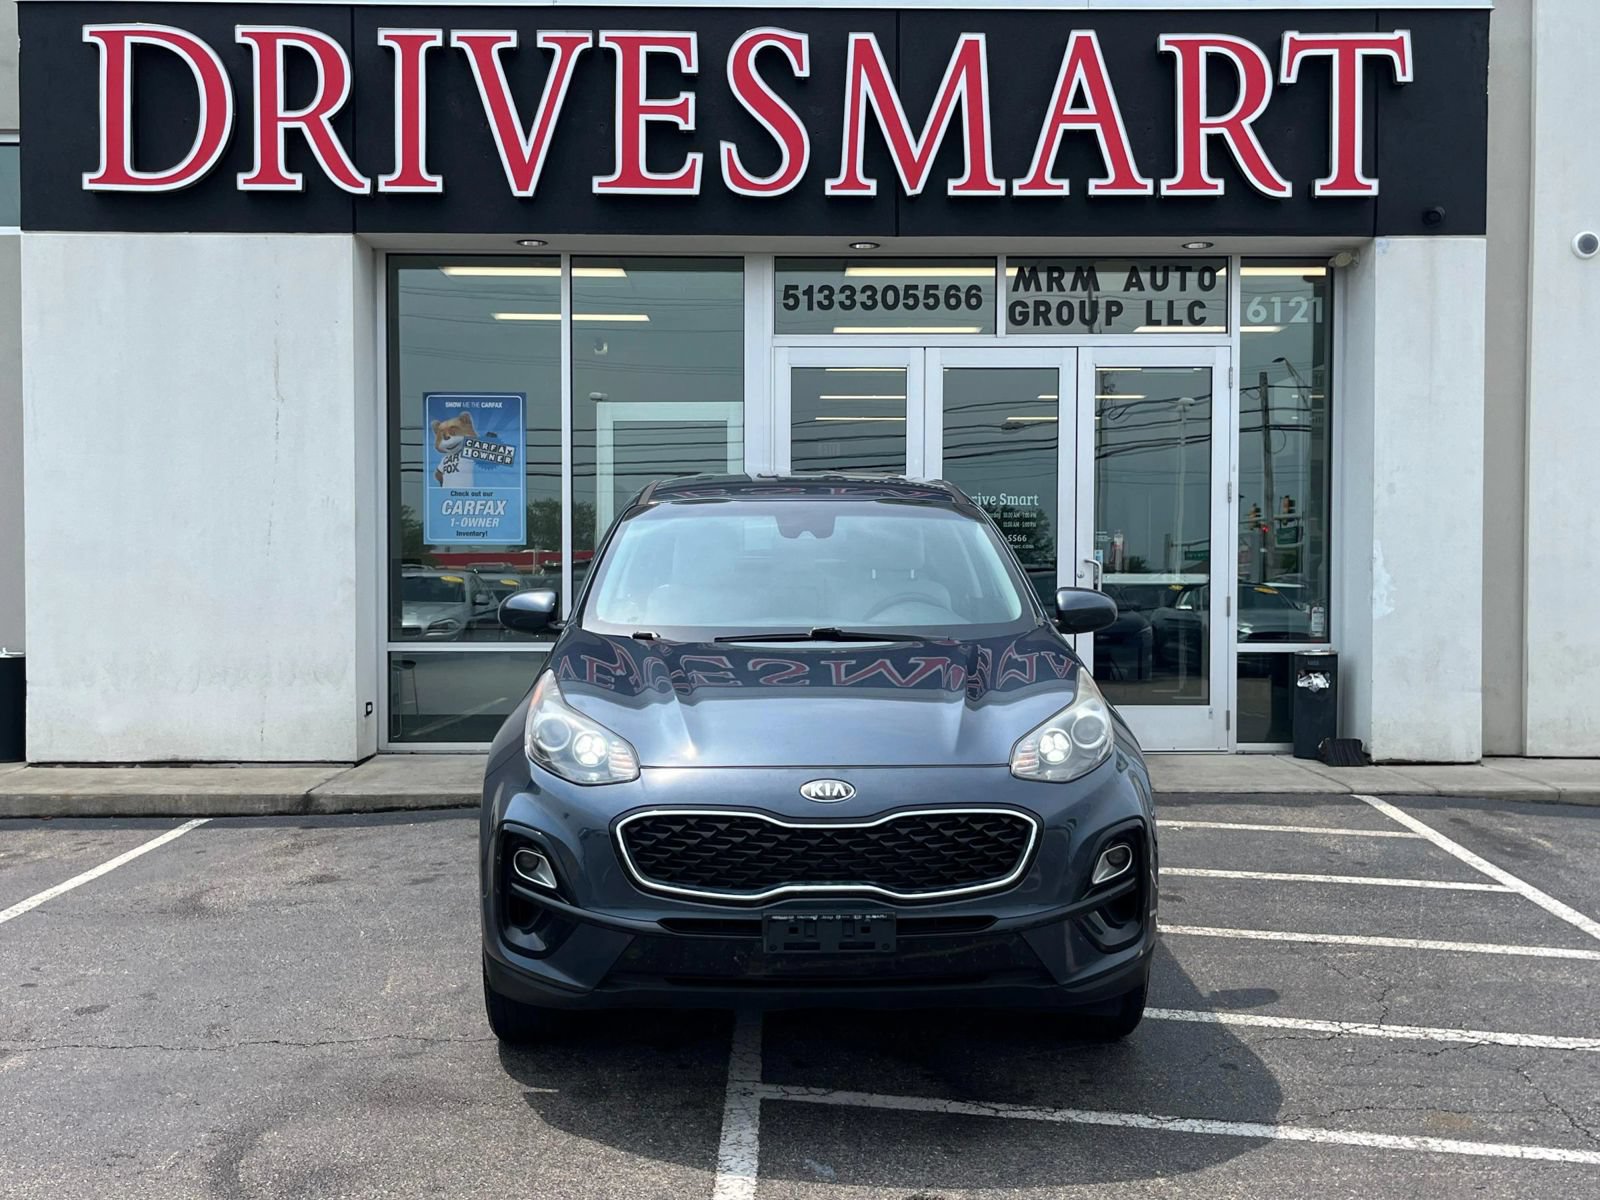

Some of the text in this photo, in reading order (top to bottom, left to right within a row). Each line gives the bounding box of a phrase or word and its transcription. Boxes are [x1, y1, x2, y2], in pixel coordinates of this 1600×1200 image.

[82, 24, 1413, 199] DRIVESMART
[1012, 265, 1217, 292] MRM AUTO
[782, 284, 983, 311] 5133305566
[1008, 300, 1207, 326] GROUP LLC
[1246, 296, 1323, 323] 6121
[466, 440, 513, 456] CARFAX
[472, 451, 512, 464] OWNER
[443, 463, 460, 474] FOX
[971, 492, 1039, 506] rive Smart
[441, 500, 506, 515] CARFAX
[810, 783, 847, 797] KIA
